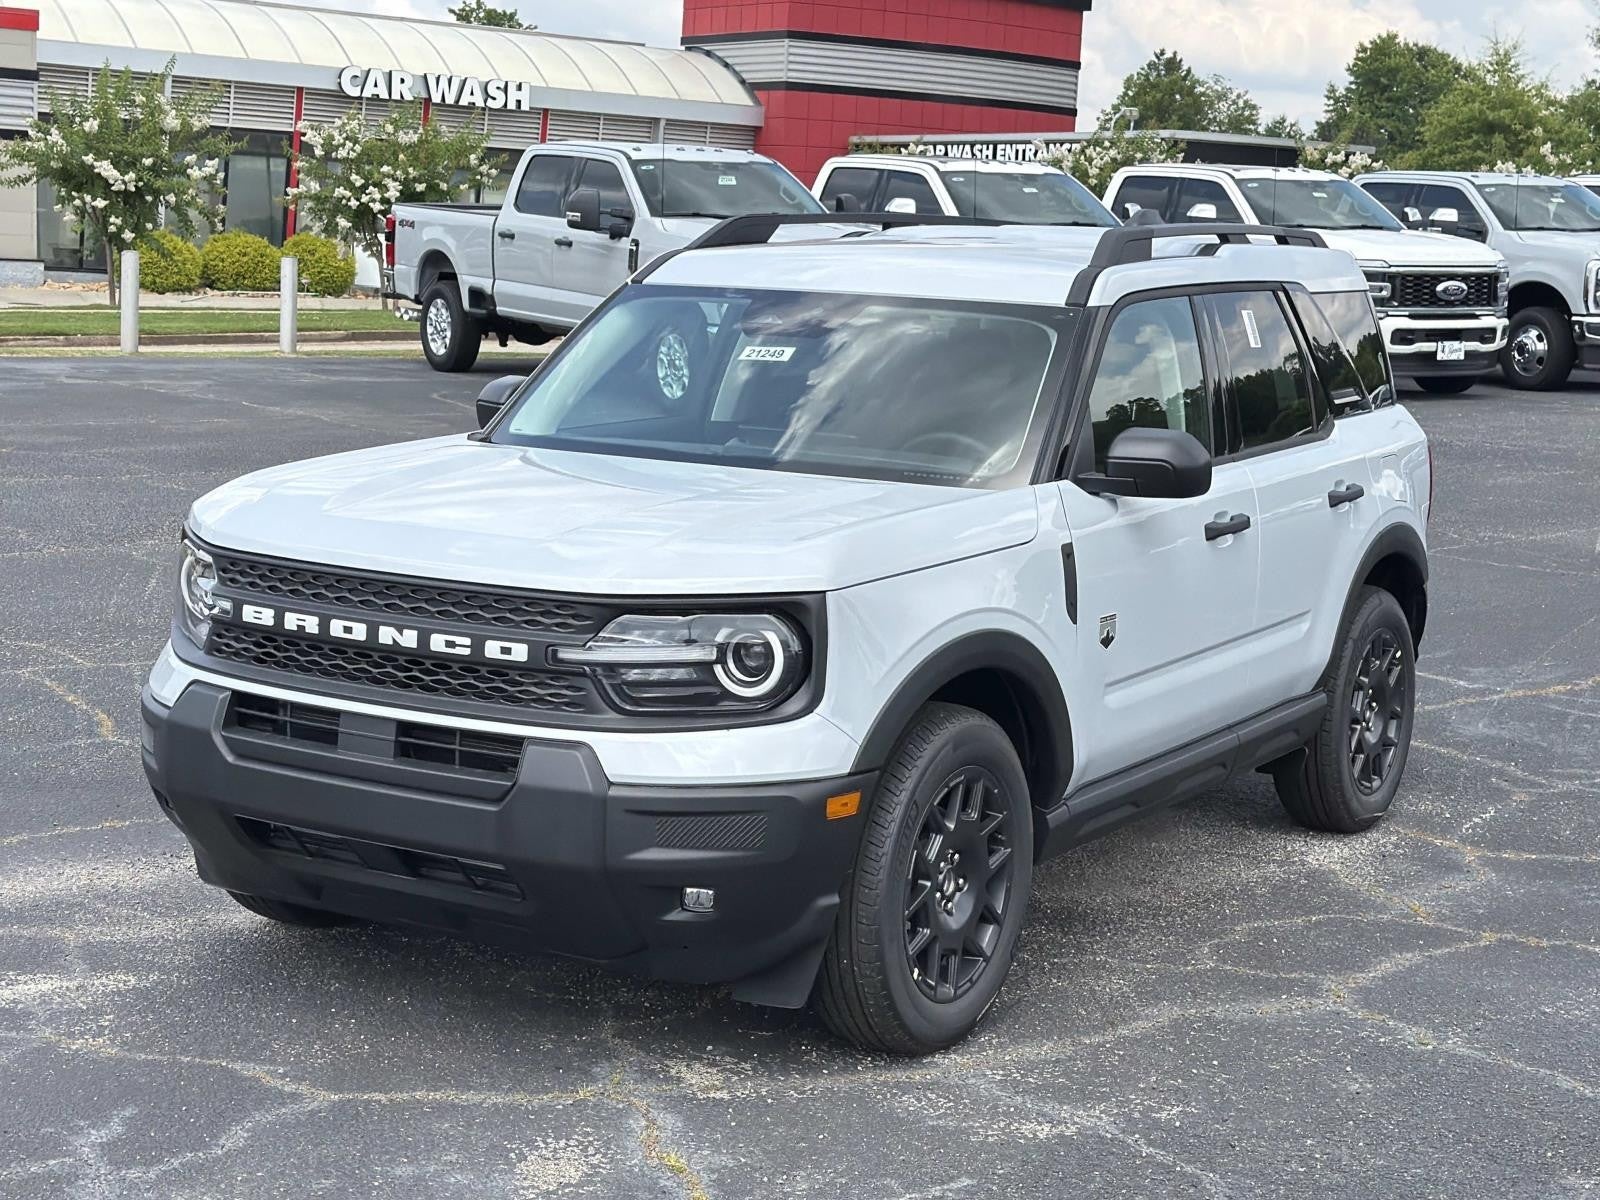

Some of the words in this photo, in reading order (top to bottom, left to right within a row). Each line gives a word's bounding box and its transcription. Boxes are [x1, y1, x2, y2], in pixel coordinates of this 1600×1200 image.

[339, 65, 414, 101] CAR
[424, 73, 531, 111] WASH
[947, 143, 993, 160] WASH
[744, 349, 785, 358] 21249
[241, 604, 529, 662] BRONCO
